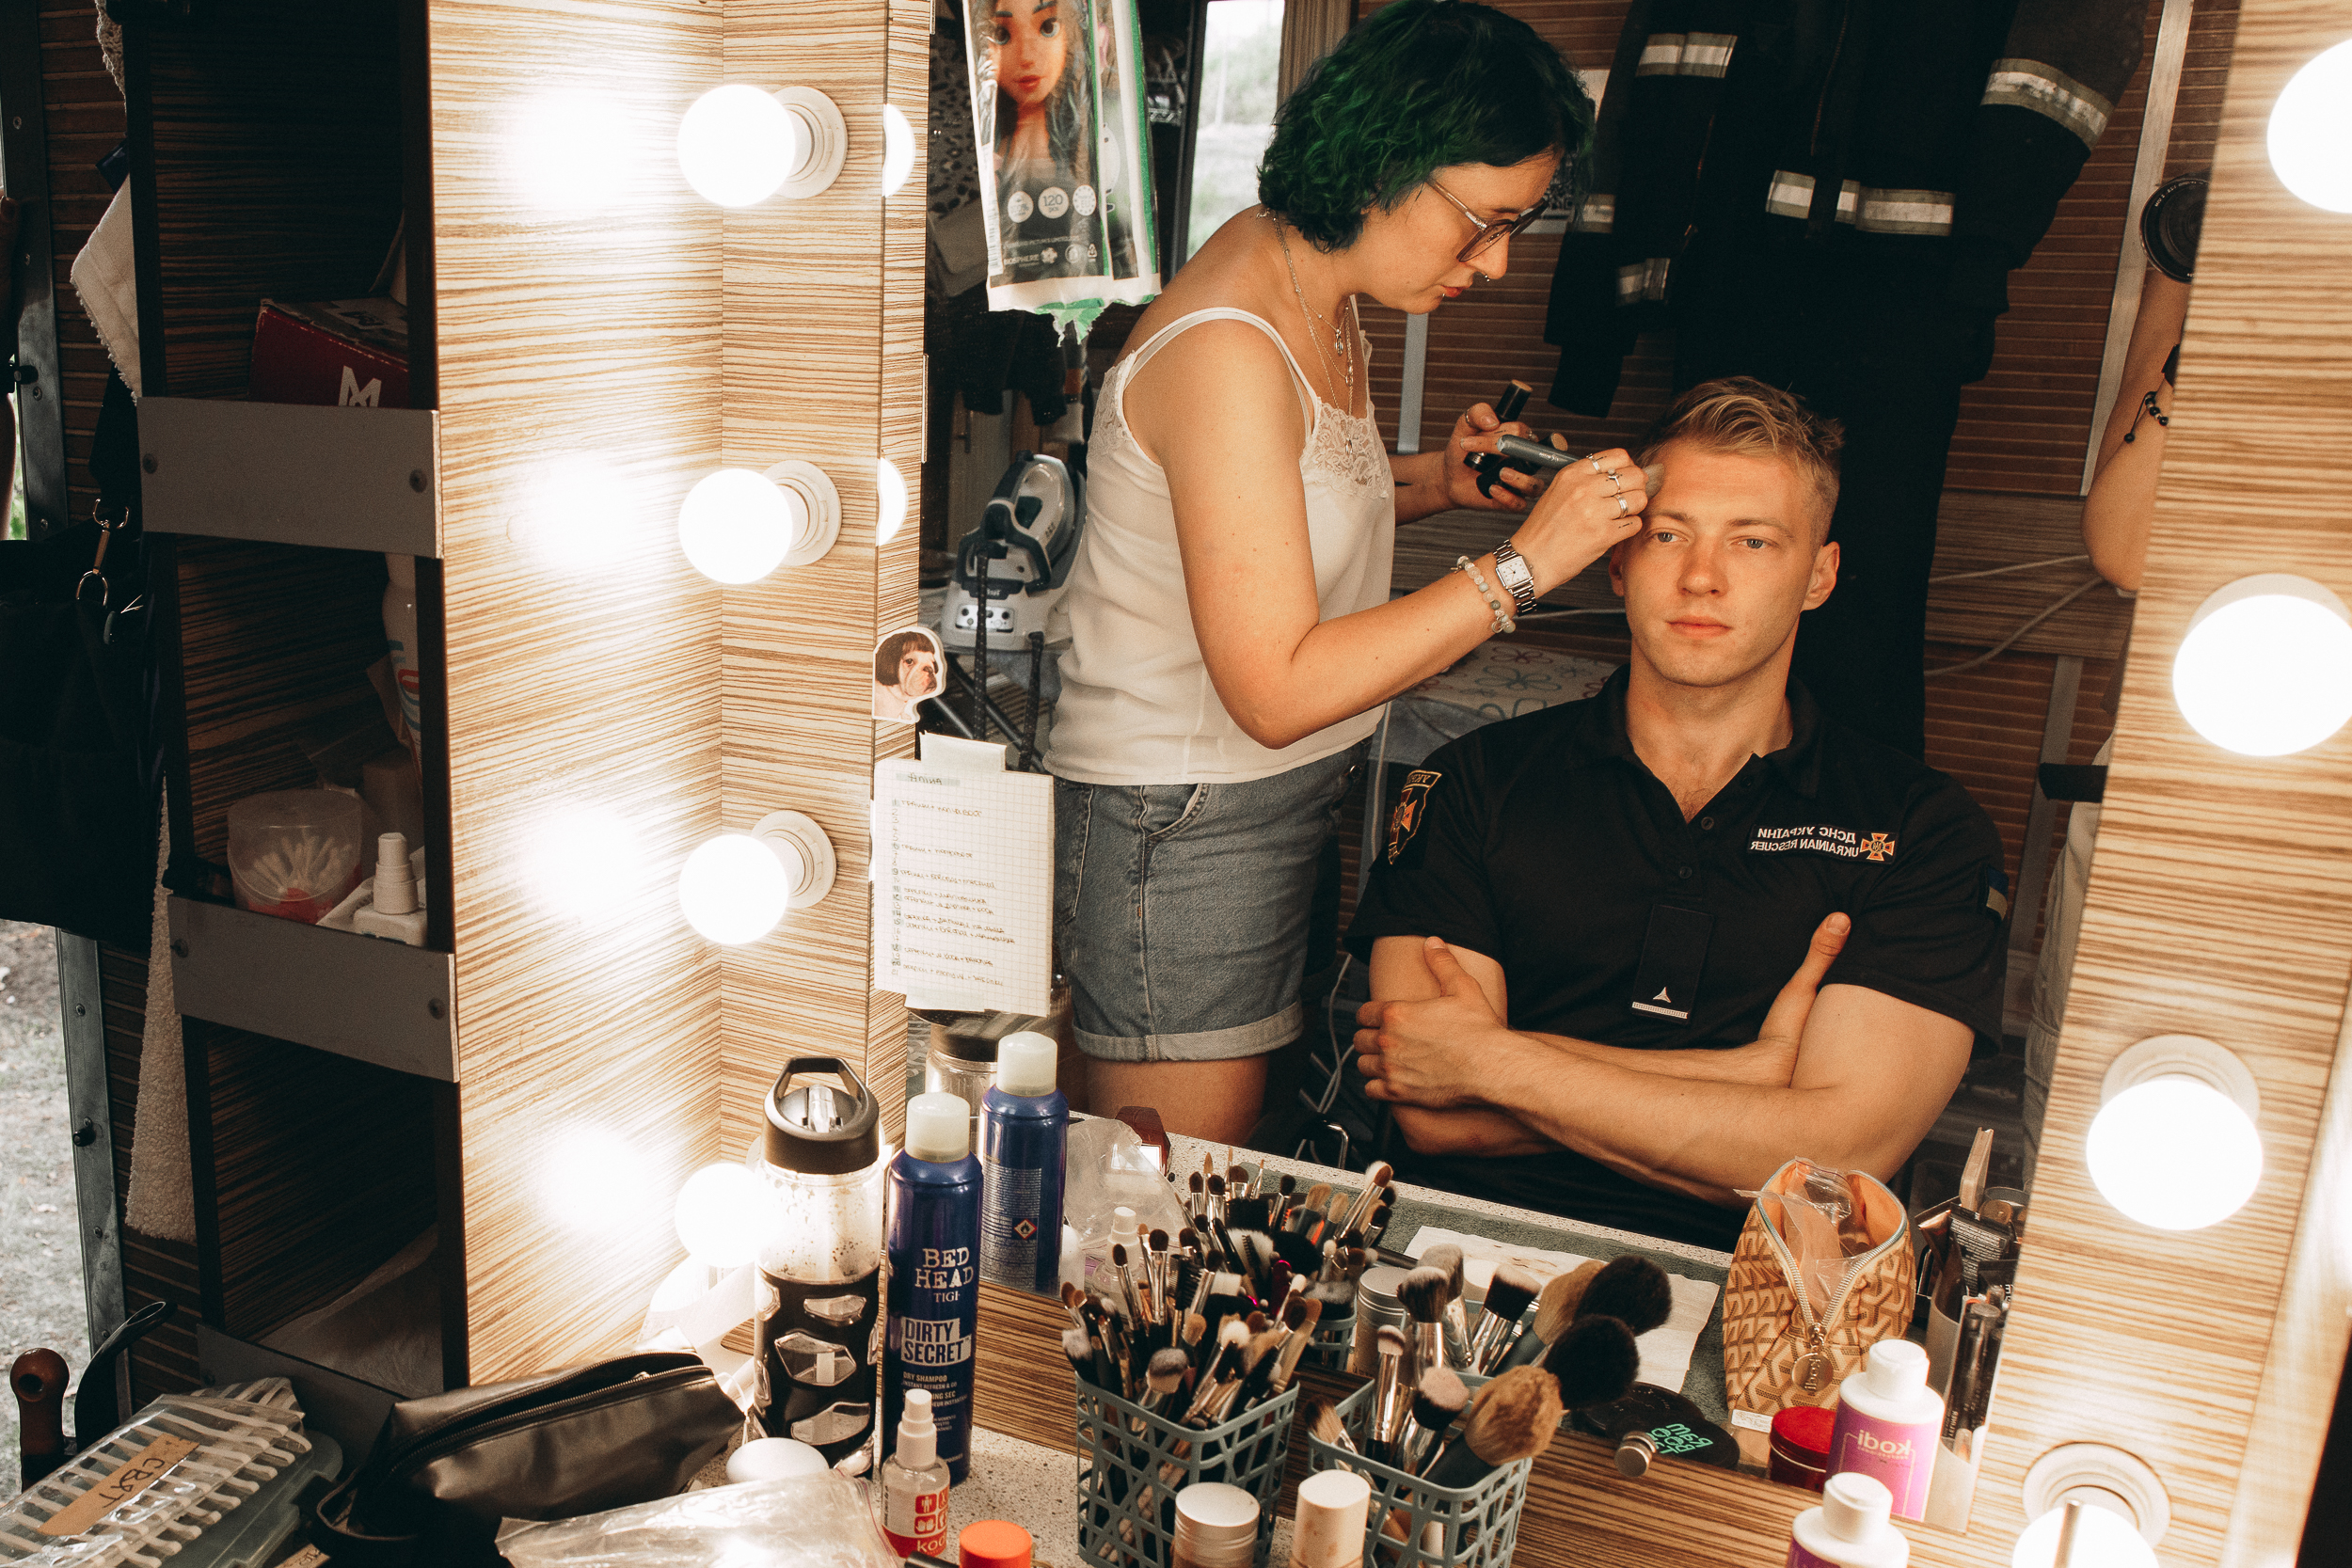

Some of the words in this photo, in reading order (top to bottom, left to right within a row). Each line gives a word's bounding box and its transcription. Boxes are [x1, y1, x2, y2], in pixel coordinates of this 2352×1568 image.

[1043, 194, 1063, 207] 120
[922, 1246, 970, 1269] BED
[914, 1266, 974, 1289] HEAD
[933, 1291, 960, 1303] TIGI
[905, 1318, 954, 1343] DIRTY
[904, 1339, 964, 1364] SECRET
[903, 1371, 915, 1381] DRY
[915, 1374, 947, 1383] SHAMPOO
[945, 1390, 957, 1399] SEC
